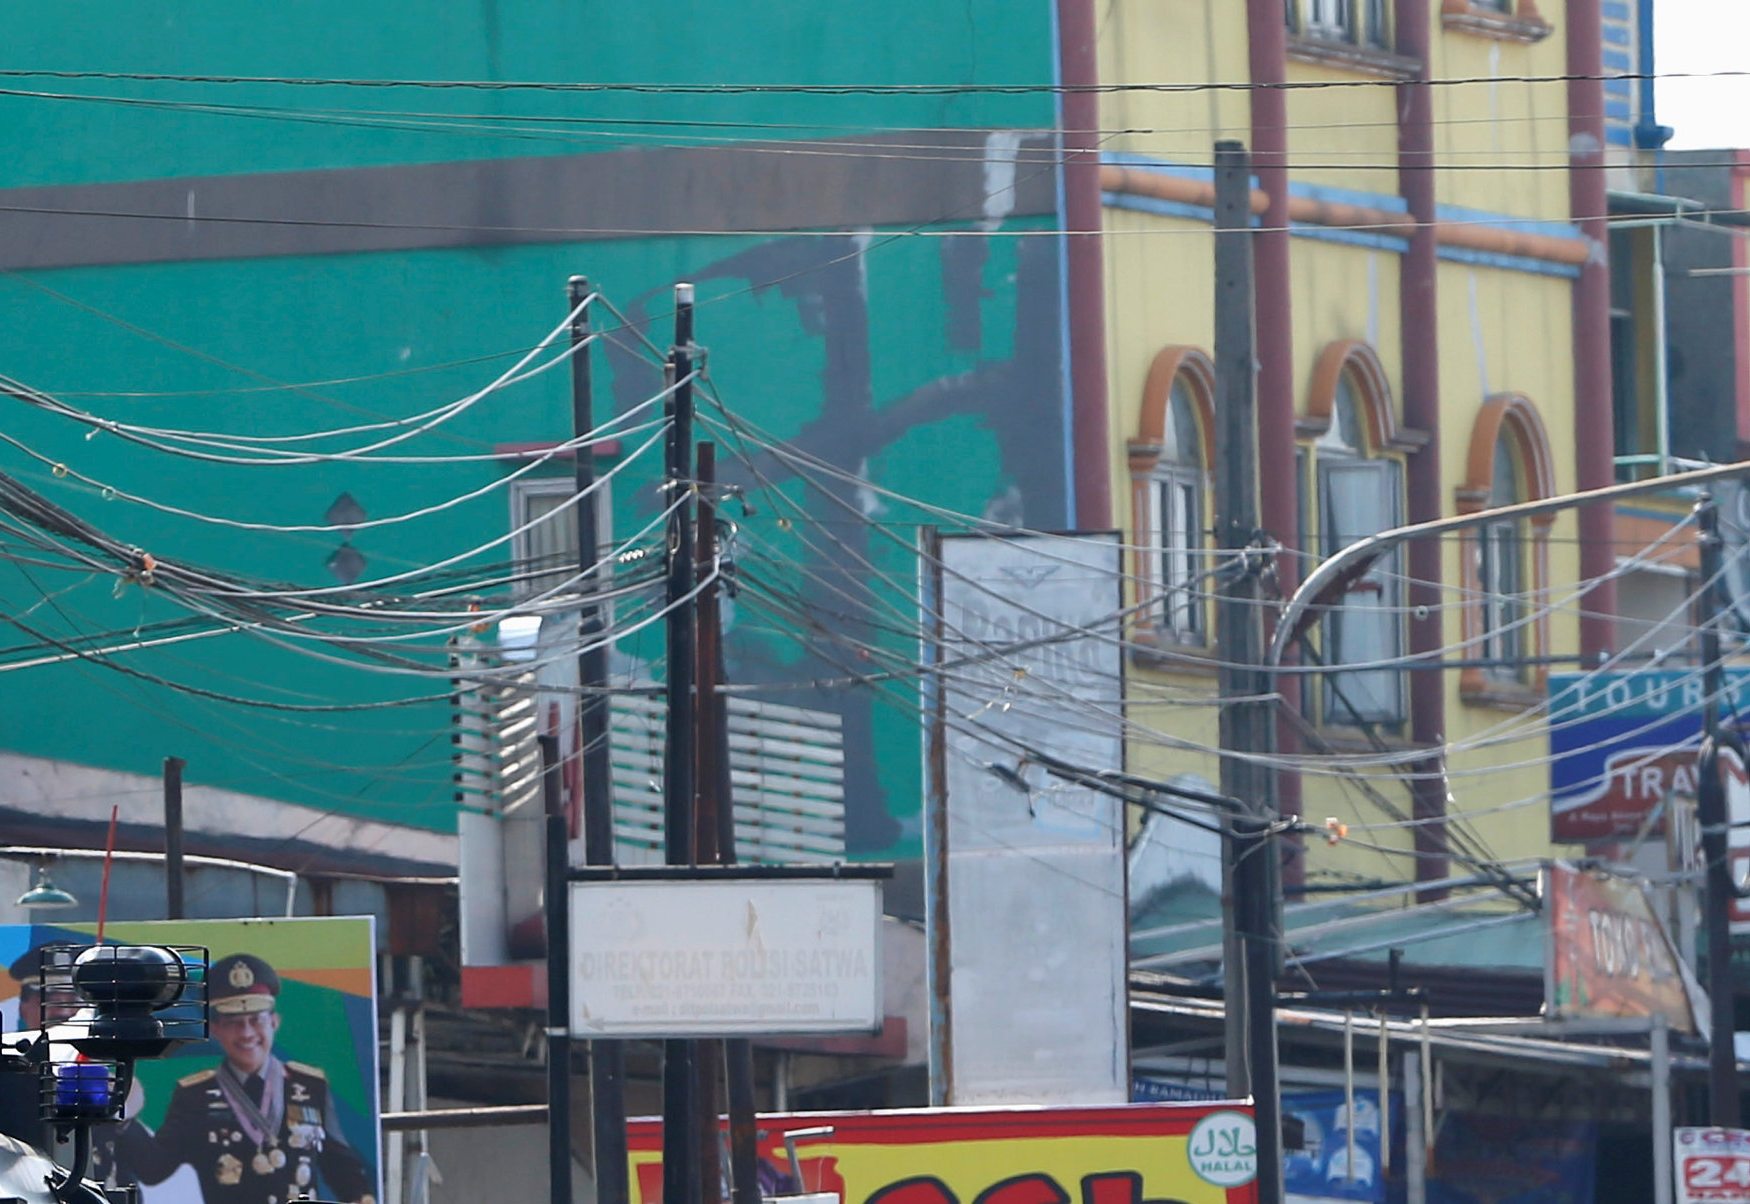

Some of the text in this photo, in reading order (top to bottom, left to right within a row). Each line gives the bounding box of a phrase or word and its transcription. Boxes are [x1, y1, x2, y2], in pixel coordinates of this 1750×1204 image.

[581, 950, 715, 981] DIREKTORAT
[795, 948, 868, 978] SATWA
[1201, 1160, 1253, 1172] HALAL
